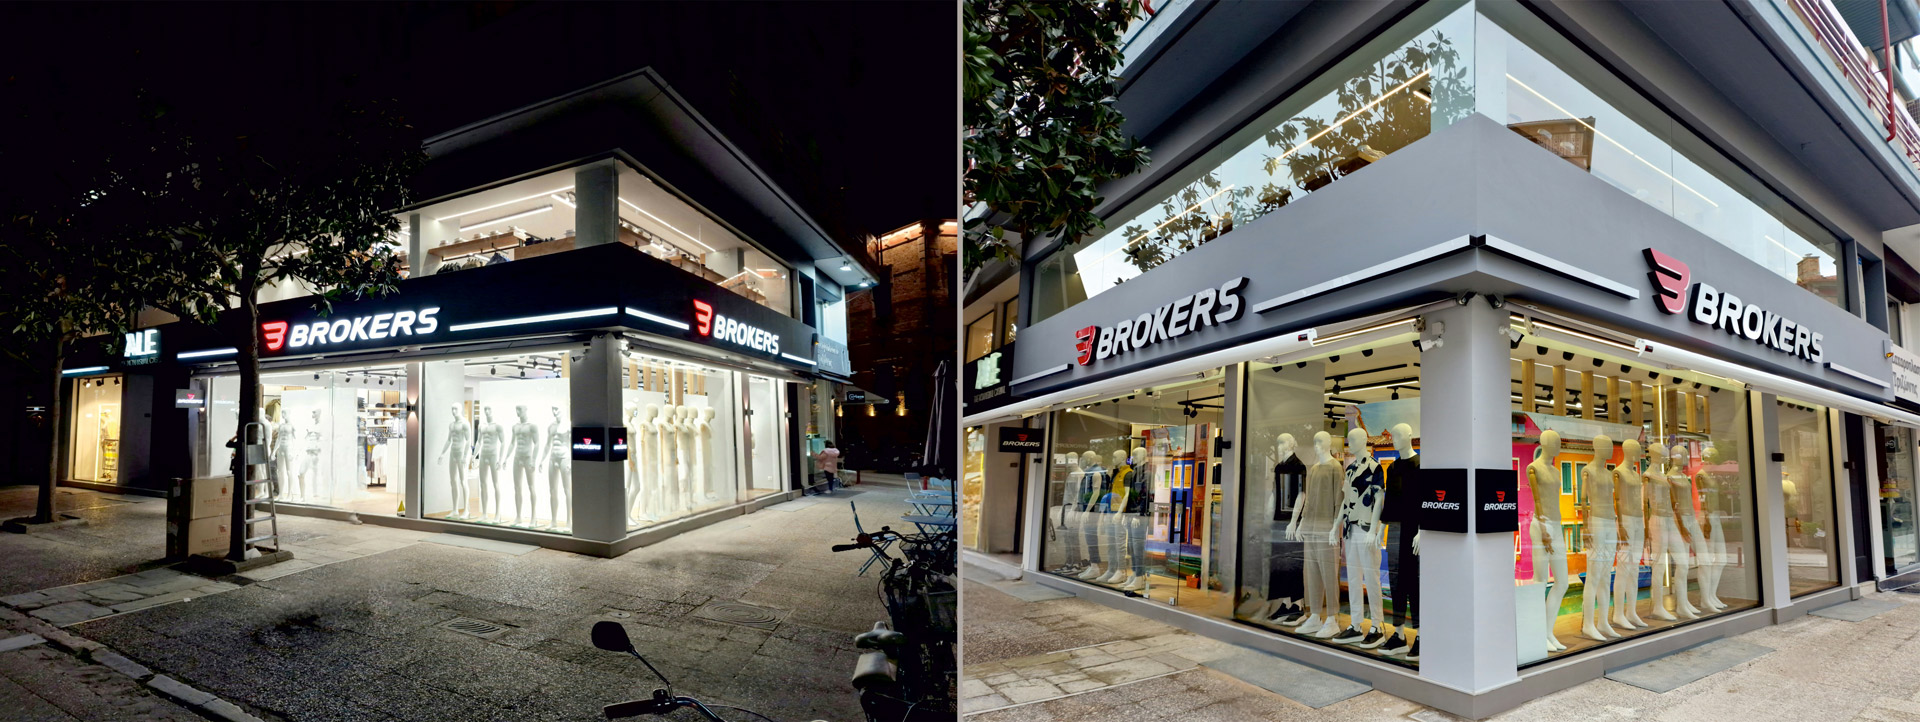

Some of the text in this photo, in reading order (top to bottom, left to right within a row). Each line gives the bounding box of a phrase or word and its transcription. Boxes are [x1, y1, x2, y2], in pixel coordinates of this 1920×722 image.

[288, 307, 440, 348] BROKERS
[713, 314, 779, 355] BROKERS
[1096, 276, 1250, 360] BROKERS
[1689, 282, 1824, 364] BROKERS
[1002, 440, 1041, 448] BROKERS
[1421, 501, 1460, 511] BROKERS
[1483, 502, 1517, 511] BROKERS
